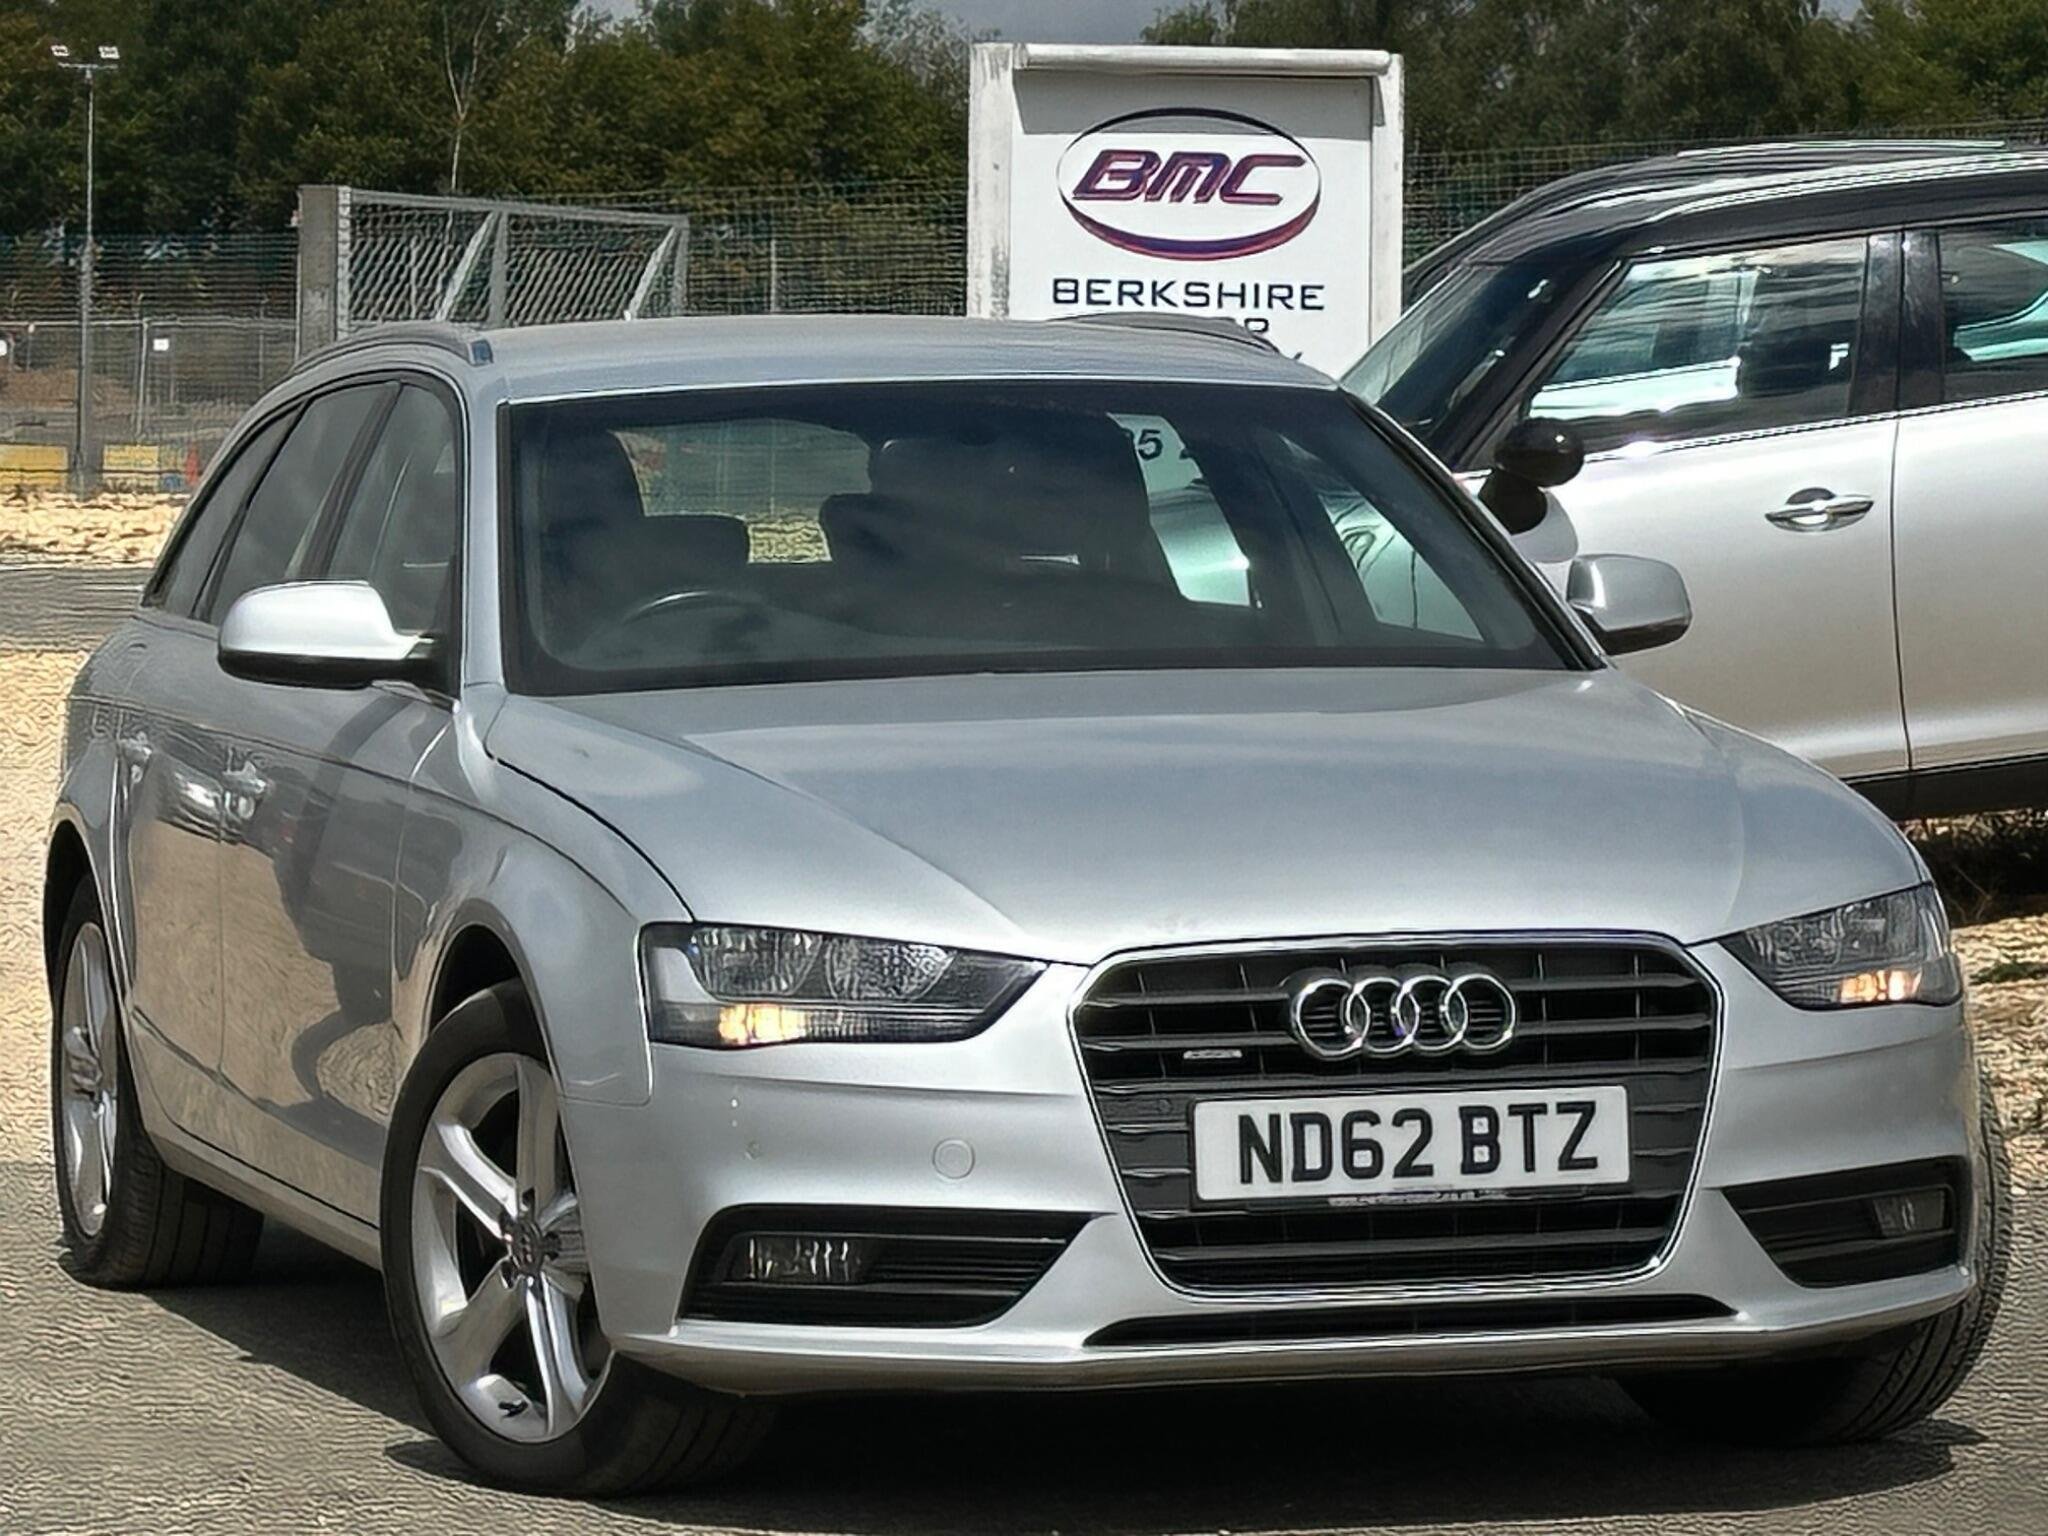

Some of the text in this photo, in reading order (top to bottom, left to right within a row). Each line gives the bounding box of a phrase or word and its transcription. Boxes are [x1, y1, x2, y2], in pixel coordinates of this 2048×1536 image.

[1073, 149, 1307, 206] BMC
[1052, 278, 1325, 311] BERKSHIRE
[1128, 428, 1164, 461] 5
[1238, 1100, 1599, 1185] ND62 BTZ
